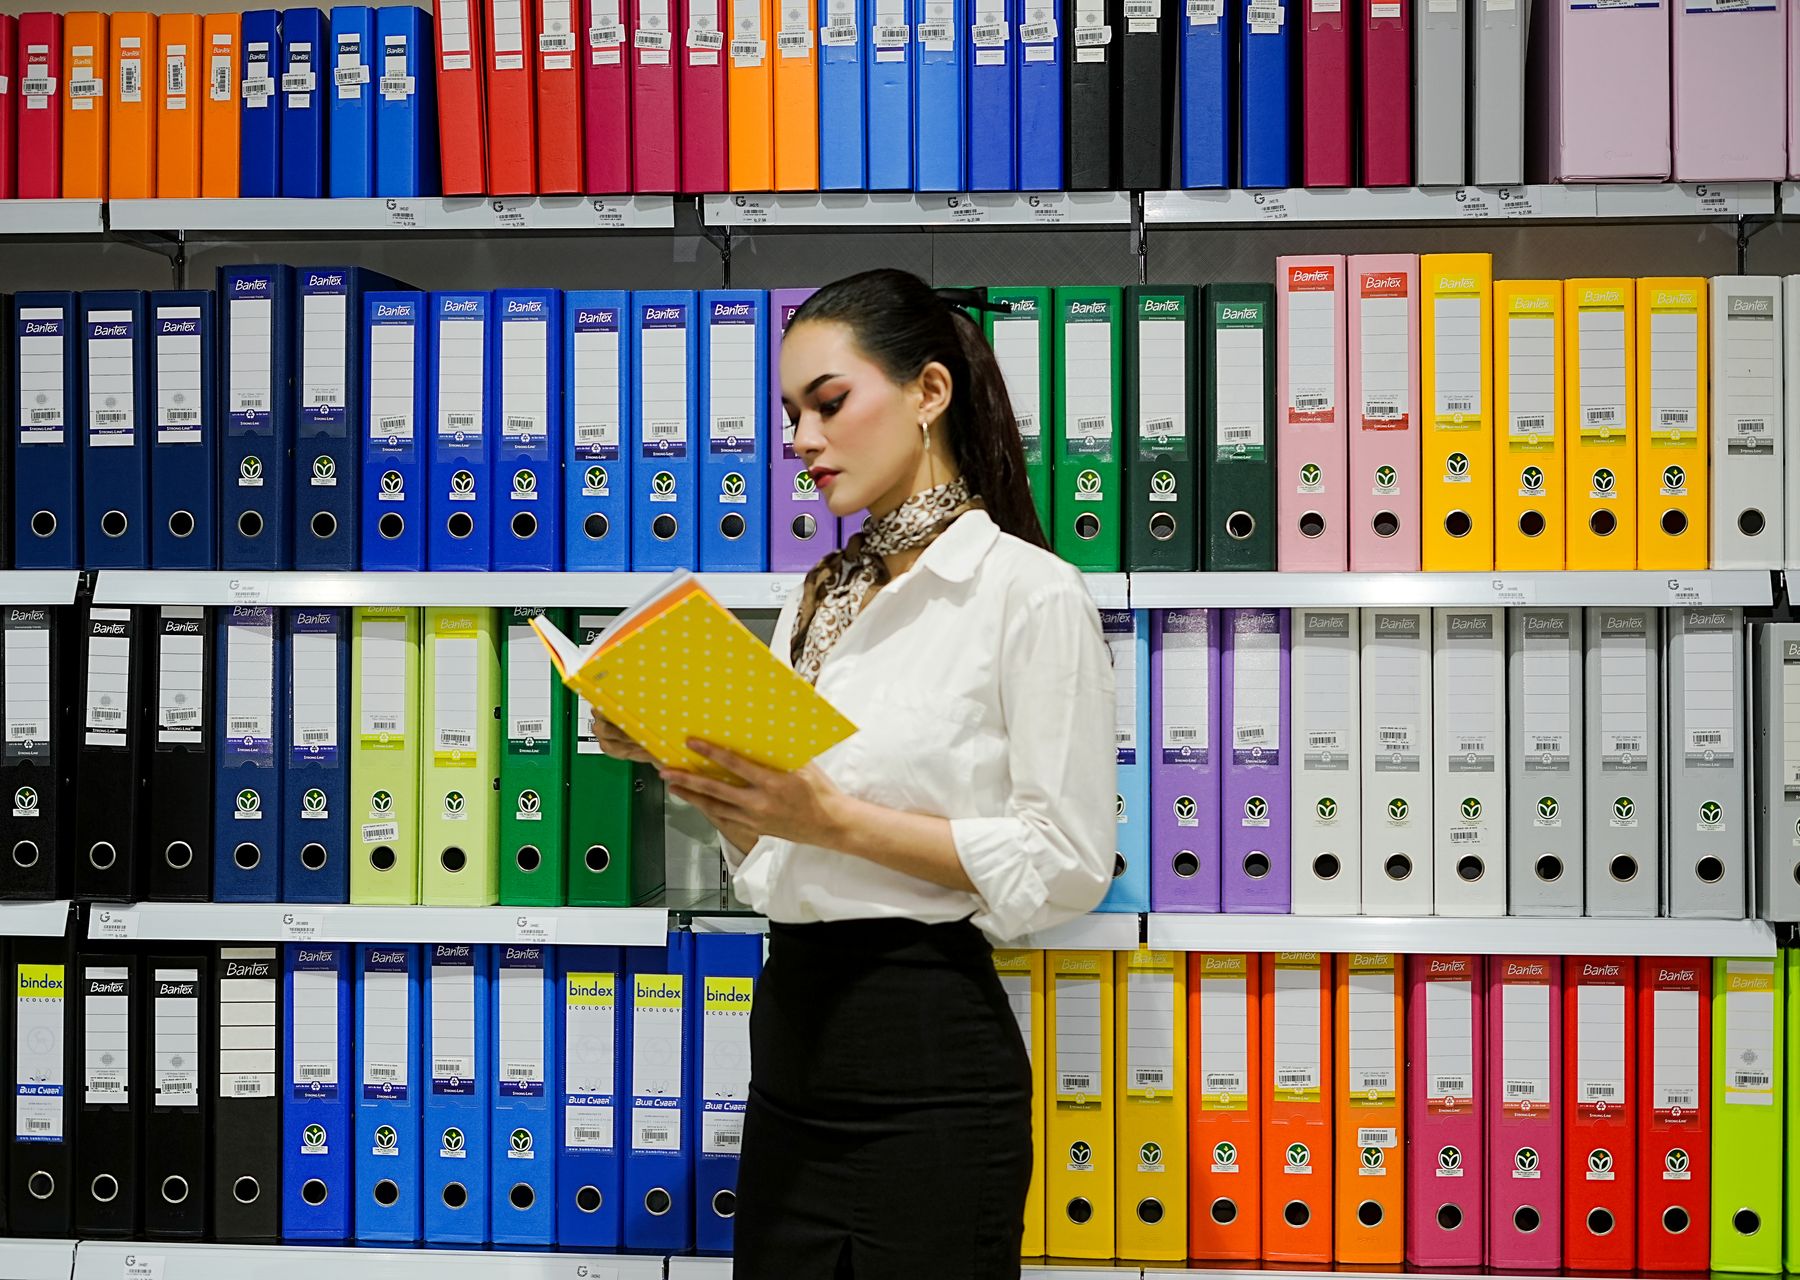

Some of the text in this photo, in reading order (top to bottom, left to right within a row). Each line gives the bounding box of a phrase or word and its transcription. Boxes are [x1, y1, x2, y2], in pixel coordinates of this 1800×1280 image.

[309, 274, 342, 286] Bantex
[1293, 270, 1329, 282] Bantex
[235, 279, 267, 291] Bantex
[1365, 277, 1401, 289] Bantex
[1439, 277, 1475, 289] Bantex
[1514, 296, 1550, 309] Bantex
[1584, 290, 1620, 303] Bantex
[1656, 292, 1693, 305] Bantex
[377, 304, 411, 316] Bantex
[444, 300, 478, 312] Bantex
[508, 301, 542, 312] Bantex
[714, 303, 749, 316] Bantex
[1071, 301, 1106, 314] Bantex
[1144, 299, 1180, 312] Bantex
[1733, 299, 1769, 312] Bantex
[579, 311, 612, 323] Bantex
[646, 308, 680, 319] Bantex
[1222, 307, 1259, 320] Bantex
[26, 322, 58, 333] Bantex
[94, 325, 128, 336] Bantex
[163, 321, 196, 332] Bantex
[11, 609, 45, 621] Bantex
[232, 605, 268, 617] Bantex
[297, 612, 331, 624] Bantex
[440, 617, 472, 630] Bantex
[1308, 616, 1344, 629] Bantex
[1380, 617, 1416, 630] Bantex
[1451, 617, 1487, 630] Bantex
[1528, 616, 1564, 630] Bantex
[1607, 616, 1643, 630] Bantex
[1689, 612, 1726, 626] Bantex
[93, 622, 126, 634] Bantex
[165, 620, 199, 632] Bantex
[298, 950, 332, 962] Bantex
[436, 944, 470, 957] Bantex
[506, 947, 540, 960] Bantex
[371, 951, 405, 964] Bantex
[1205, 957, 1241, 970] Bantex
[1353, 954, 1389, 966] Bantex
[226, 961, 269, 977] Bantex
[1430, 960, 1465, 972] Bantex
[1507, 963, 1543, 976] Bantex
[1582, 964, 1620, 976] Bantex
[20, 973, 63, 989] bindex
[1658, 968, 1695, 982] Bantex
[90, 981, 124, 994] Bantex
[160, 982, 194, 995] Bantex
[569, 980, 613, 997] bindex
[1732, 976, 1769, 988] Bantex
[637, 982, 681, 999] bindex
[706, 985, 751, 1002] bindex
